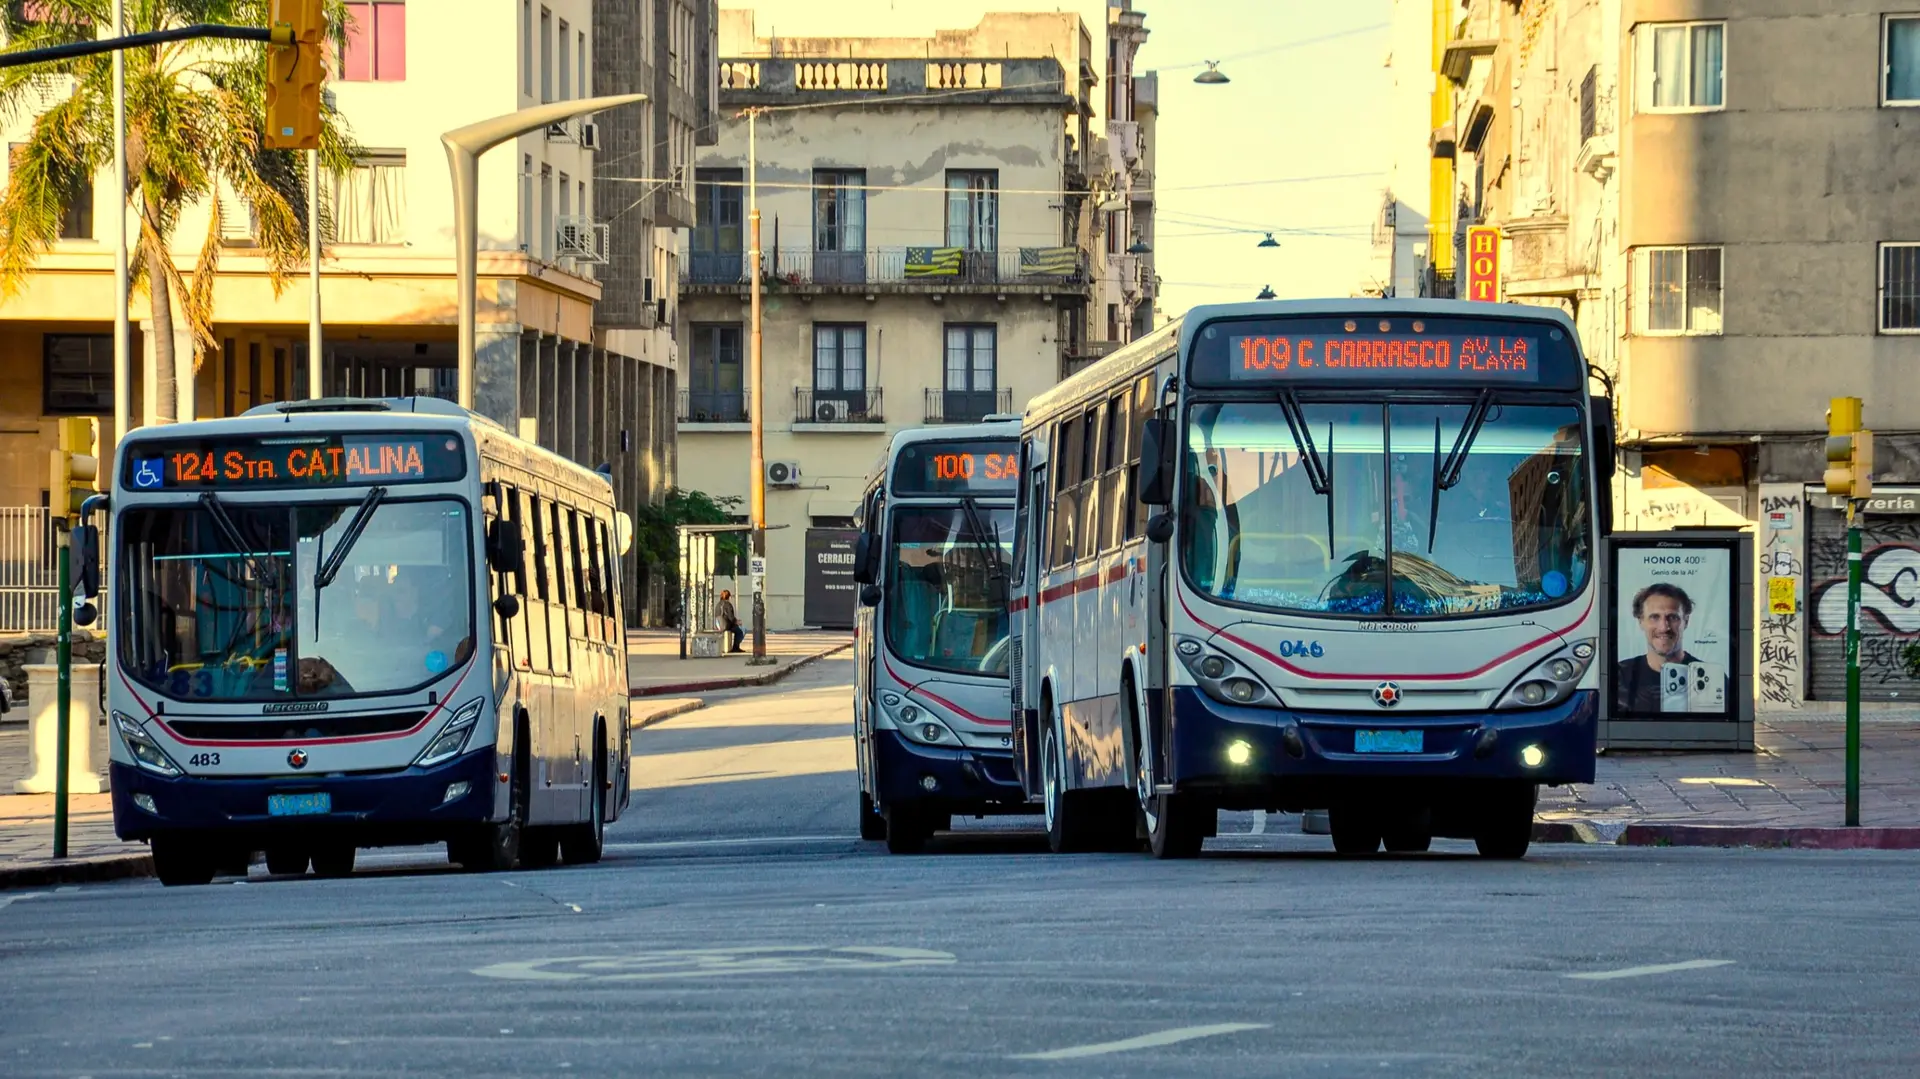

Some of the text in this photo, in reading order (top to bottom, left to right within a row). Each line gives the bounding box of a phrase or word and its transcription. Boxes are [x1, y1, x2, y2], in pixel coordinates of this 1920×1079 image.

[1474, 234, 1494, 300] HOT
[1240, 337, 1451, 370] 109 C. CARRASCO
[1462, 337, 1527, 354] AV. LA
[1459, 354, 1527, 370] PLAYA
[172, 452, 218, 481] 124
[287, 444, 424, 477] CATALINA
[933, 452, 1019, 480] 100 SA
[1831, 496, 1916, 509] Lrería
[1643, 556, 1682, 565] HONOR
[1684, 556, 1701, 565] 400
[1279, 640, 1325, 658] 046
[264, 702, 328, 713] Marcopolo
[1000, 735, 1013, 748] 9
[189, 752, 221, 767] 483
